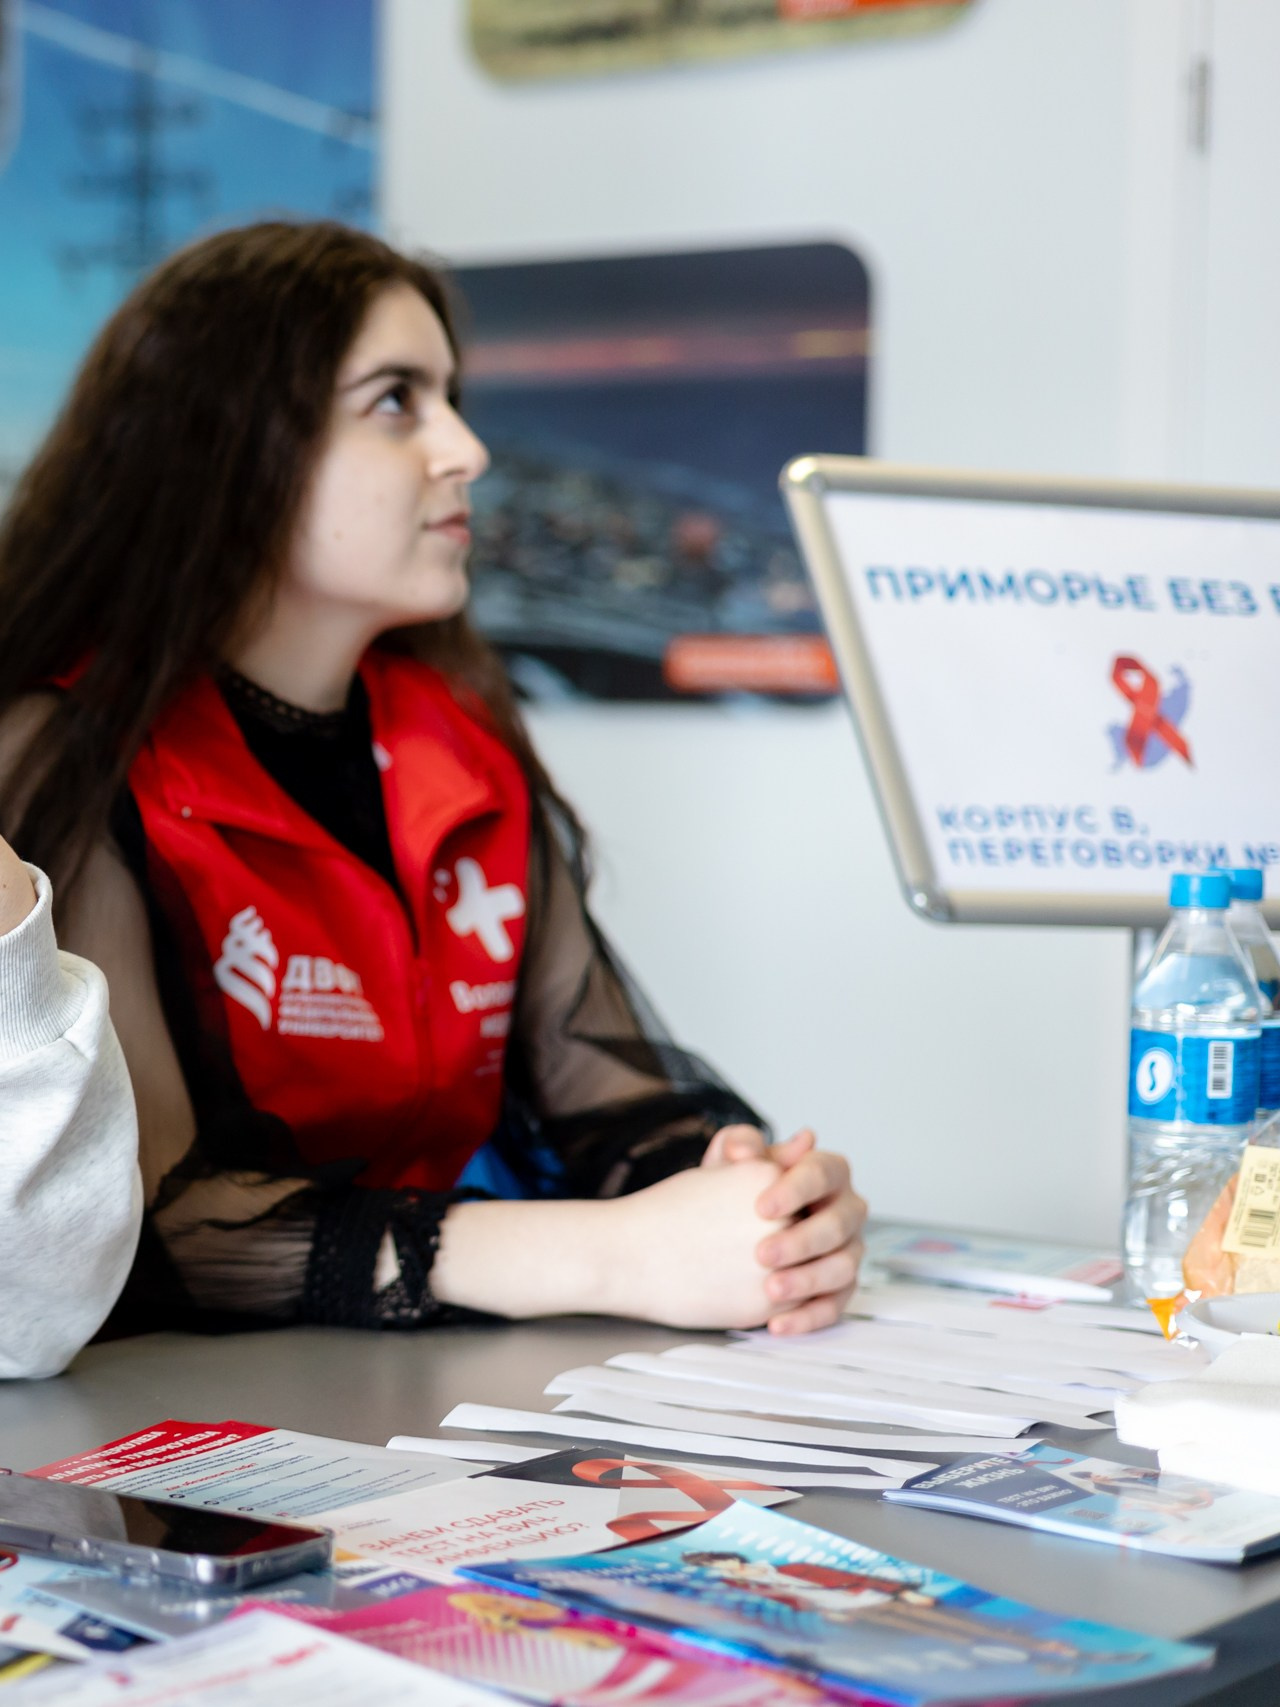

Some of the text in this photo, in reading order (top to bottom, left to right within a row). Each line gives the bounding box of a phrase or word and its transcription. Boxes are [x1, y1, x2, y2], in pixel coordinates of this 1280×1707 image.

[865, 564, 1158, 612] ПРИМОРЬЕ
[1166, 575, 1260, 617] БЕЗ
[936, 803, 1100, 835] КОРПУС
[947, 836, 1231, 868] ПЕРЕГОВОРКИ
[911, 1456, 1014, 1490] ВЫБЕРИТЕ
[953, 1467, 1027, 1489] ЖИЗНЬ
[358, 1498, 566, 1552] ЗАЧЕМ СДАВАТЬ
[388, 1515, 559, 1559] ТЕСТ НА ВИЧ-
[425, 1521, 590, 1566] ИНФЕКЦИЮ?
